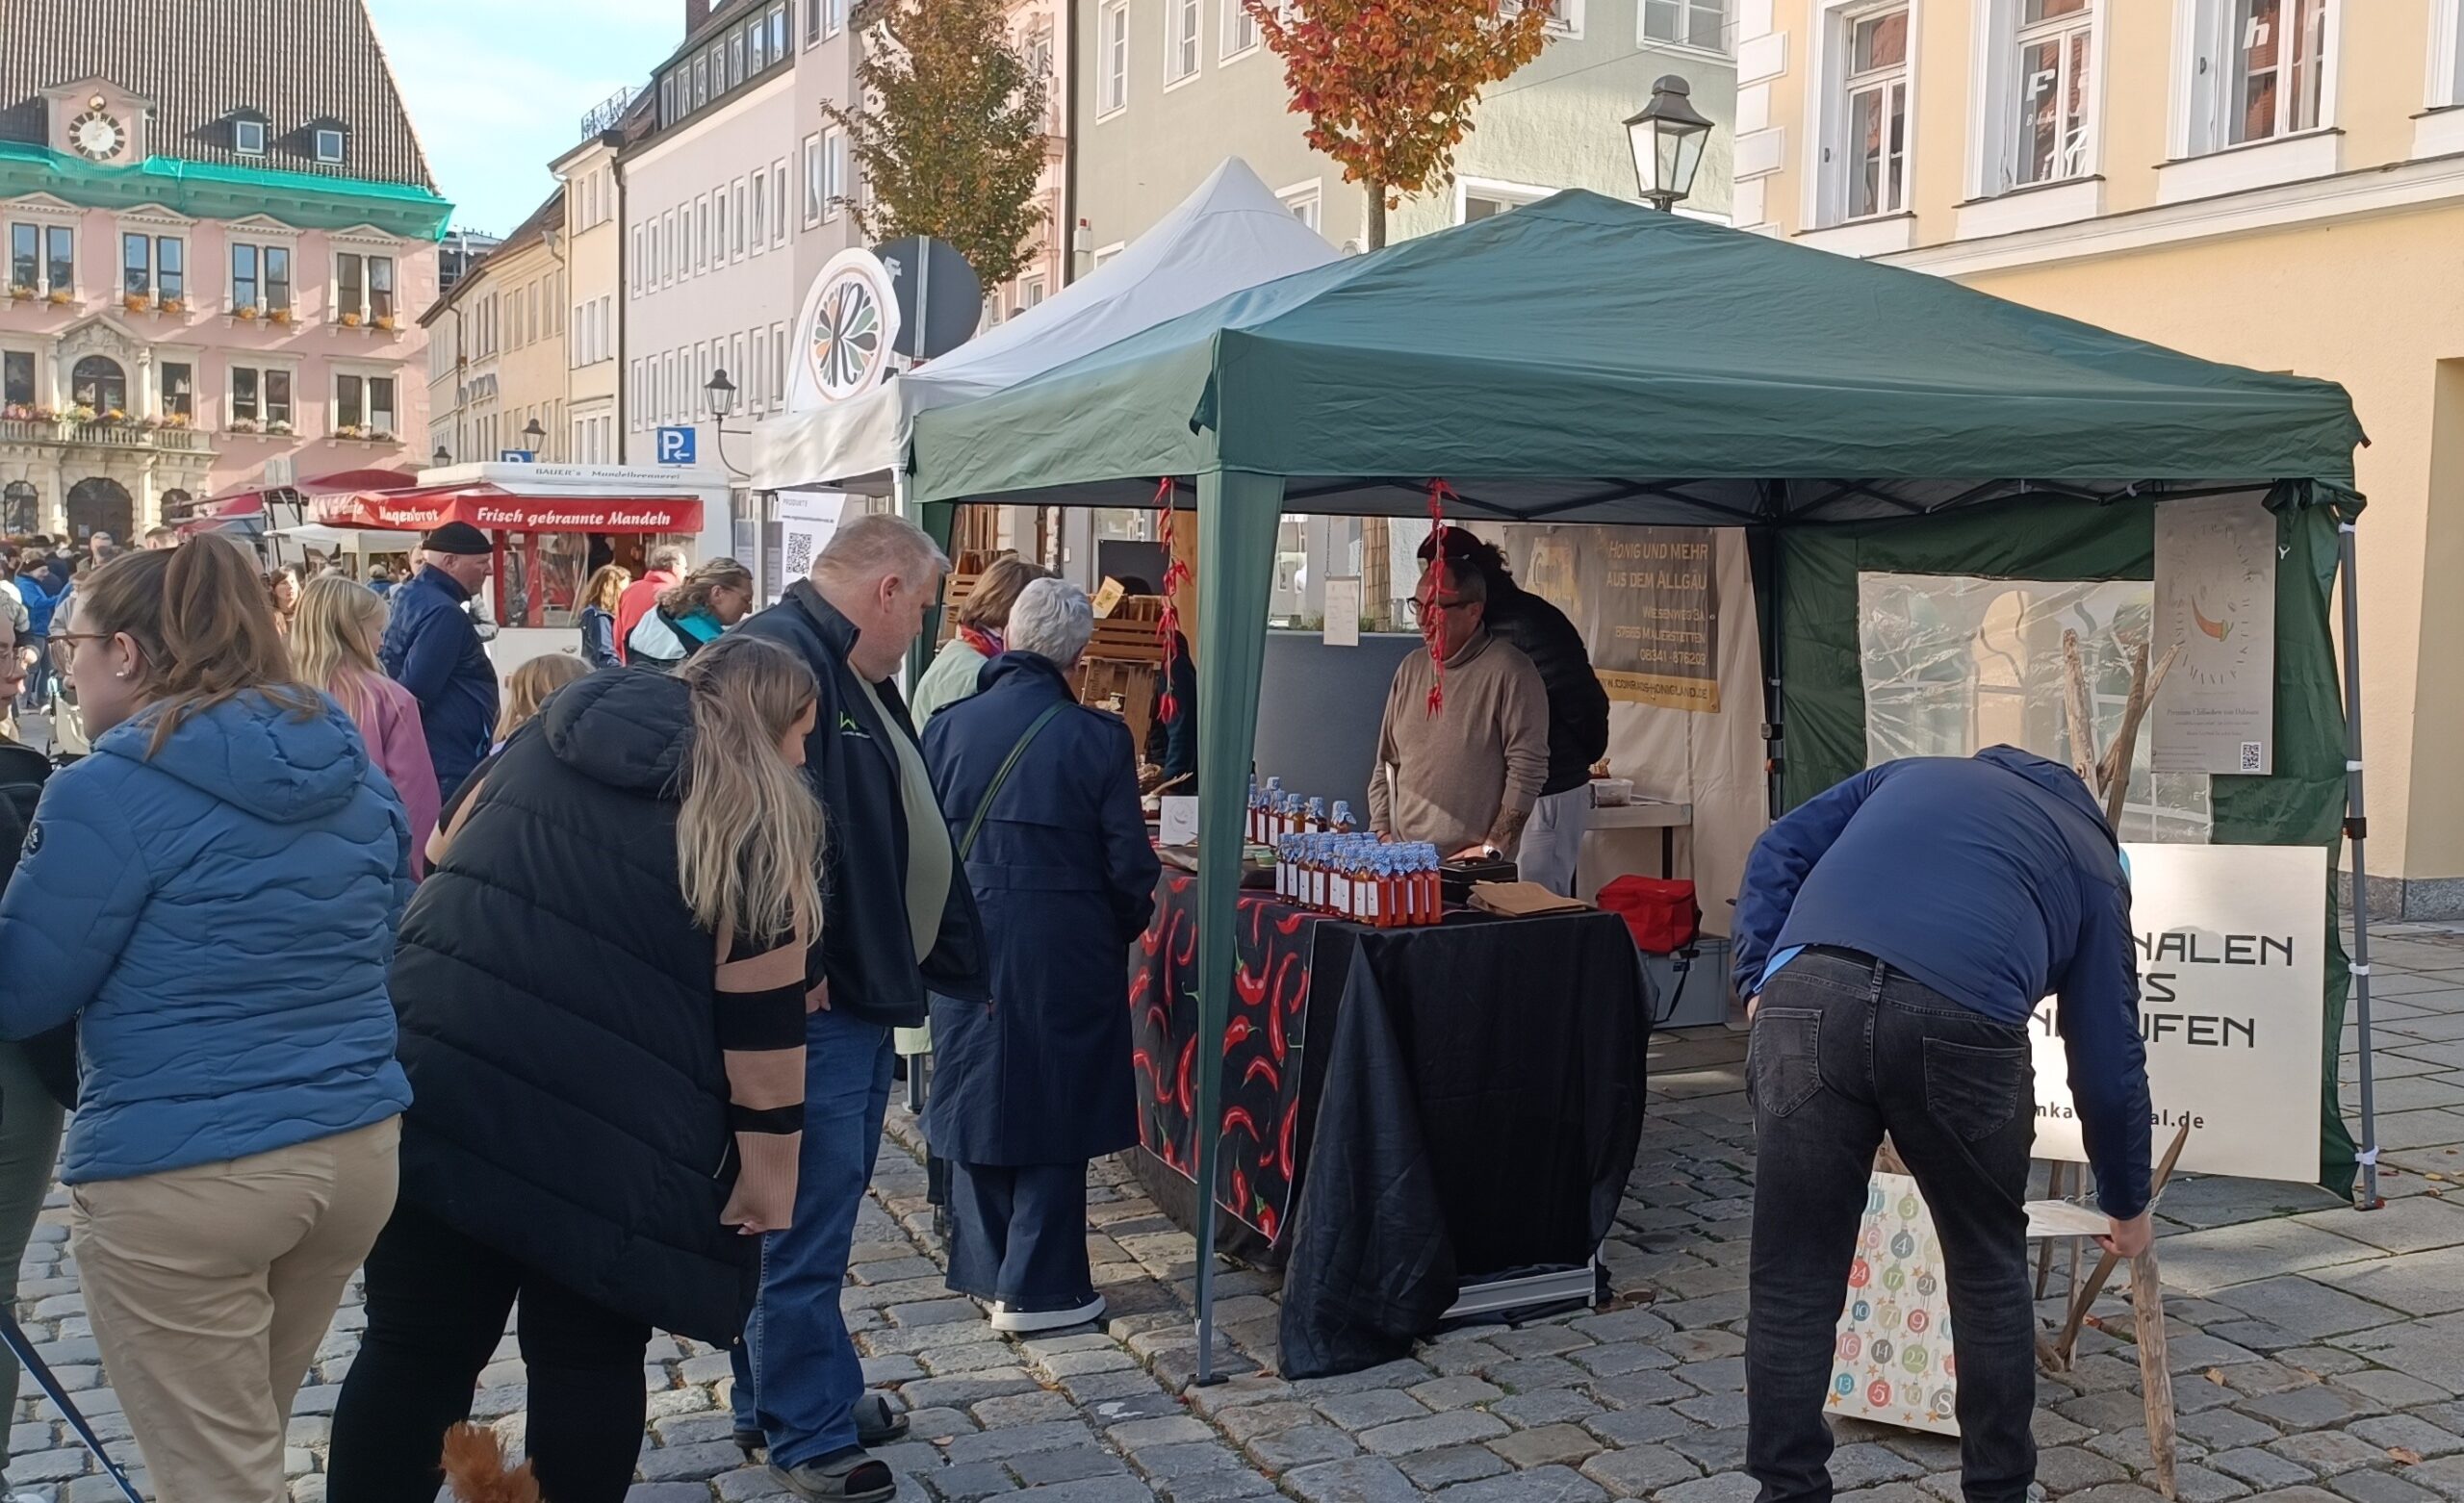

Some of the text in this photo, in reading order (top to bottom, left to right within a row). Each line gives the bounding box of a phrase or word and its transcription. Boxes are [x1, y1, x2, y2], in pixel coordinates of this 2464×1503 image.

[2025, 68, 2056, 102] F
[662, 430, 684, 460] P
[476, 507, 671, 526] Frisch gebrannte Mandeln
[1608, 540, 1708, 560] HONIG UND MEHR
[1606, 571, 1627, 587] AUS
[1630, 573, 1655, 588] DEM
[1905, 1199, 1914, 1217] 3
[1866, 1231, 1879, 1247] 6
[1894, 1236, 1909, 1255] 4
[1849, 1264, 1867, 1281] 24
[1886, 1271, 1902, 1286] 17
[1855, 1304, 1868, 1317] 10
[1886, 1311, 1897, 1325] 7
[1912, 1311, 1925, 1330] 9
[1840, 1337, 1859, 1356] 16
[1906, 1350, 1926, 1366] 22
[1838, 1377, 1852, 1392] 13
[1871, 1384, 1886, 1403] 5
[1936, 1391, 1953, 1414] 8
